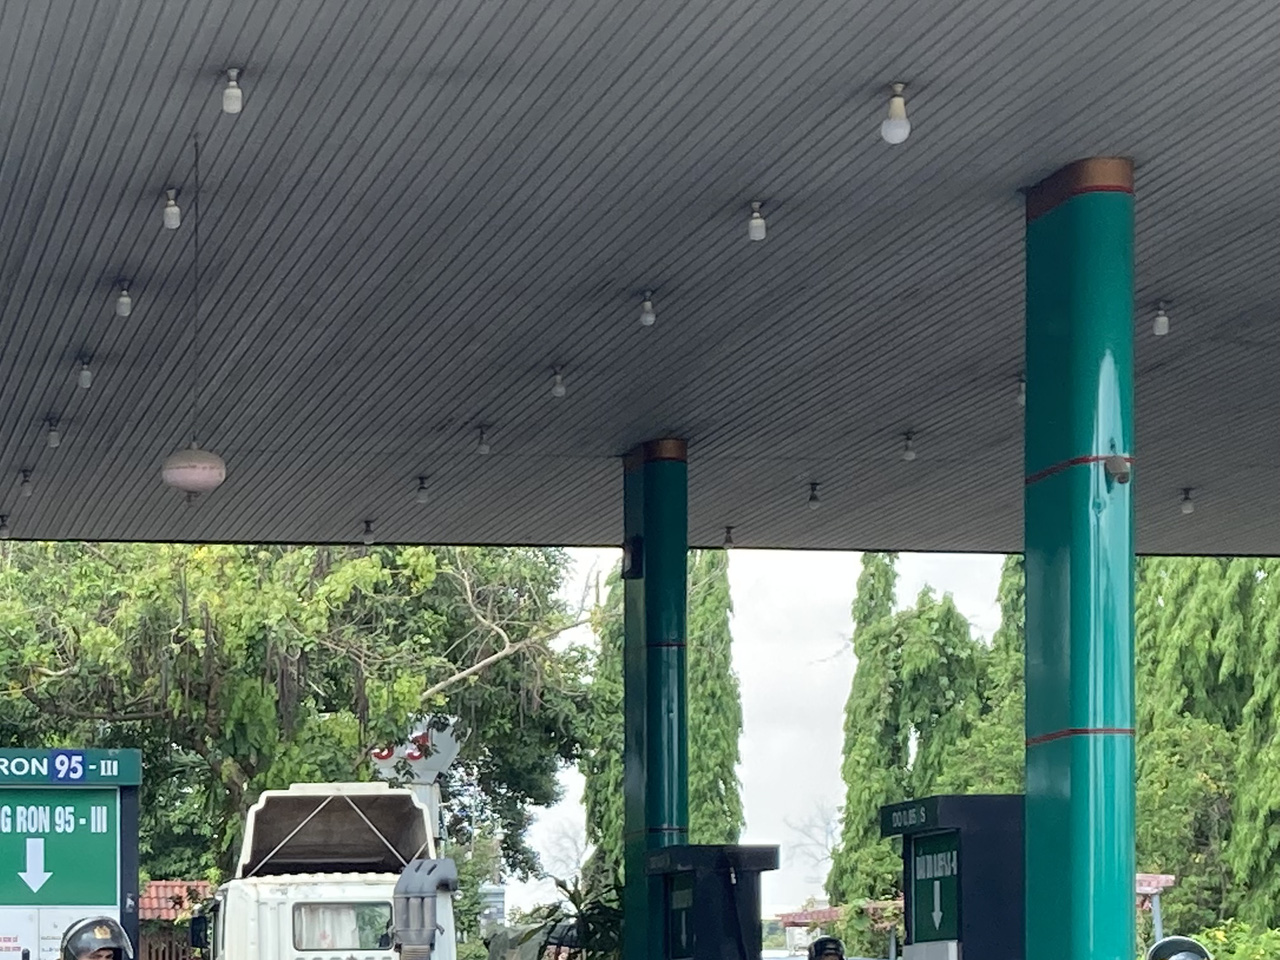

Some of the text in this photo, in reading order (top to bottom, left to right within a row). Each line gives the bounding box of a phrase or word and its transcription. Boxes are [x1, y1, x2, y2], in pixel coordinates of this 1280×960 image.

[54, 755, 83, 778] 95
[100, 760, 118, 776] III
[16, 806, 50, 833] RON
[54, 806, 75, 833] 95
[90, 806, 108, 833] III
